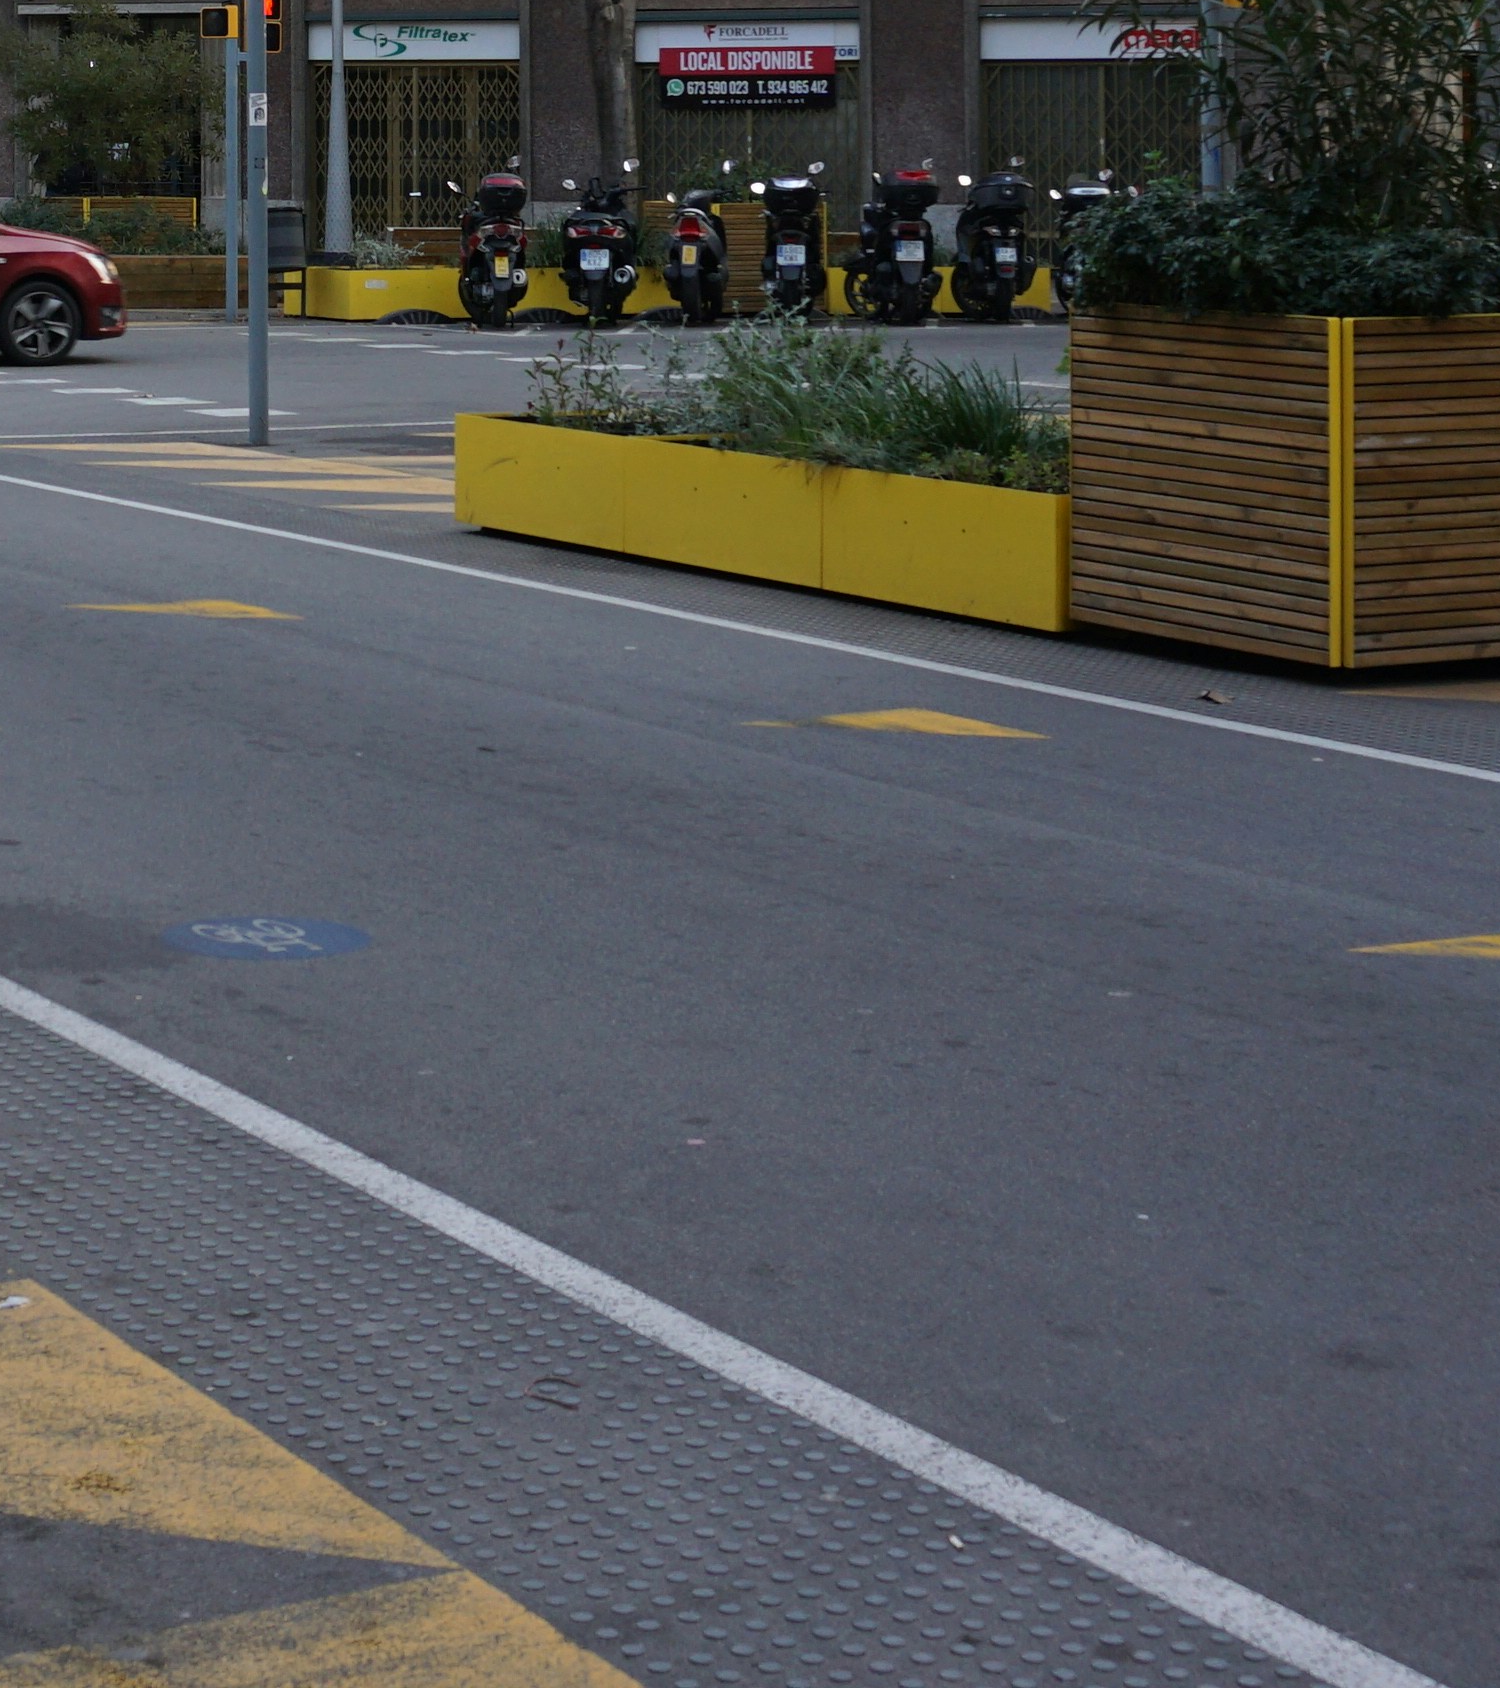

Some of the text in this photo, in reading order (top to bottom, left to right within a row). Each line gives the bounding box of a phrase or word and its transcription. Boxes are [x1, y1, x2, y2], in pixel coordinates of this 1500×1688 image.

[719, 26, 788, 37] FORCADELL
[679, 50, 814, 71] LOCAL DISPONIBLE
[687, 81, 707, 95] 673
[707, 81, 727, 95] 590
[729, 81, 749, 95] 023
[767, 81, 788, 94] 934
[789, 81, 809, 94] 965
[810, 80, 828, 94] 412
